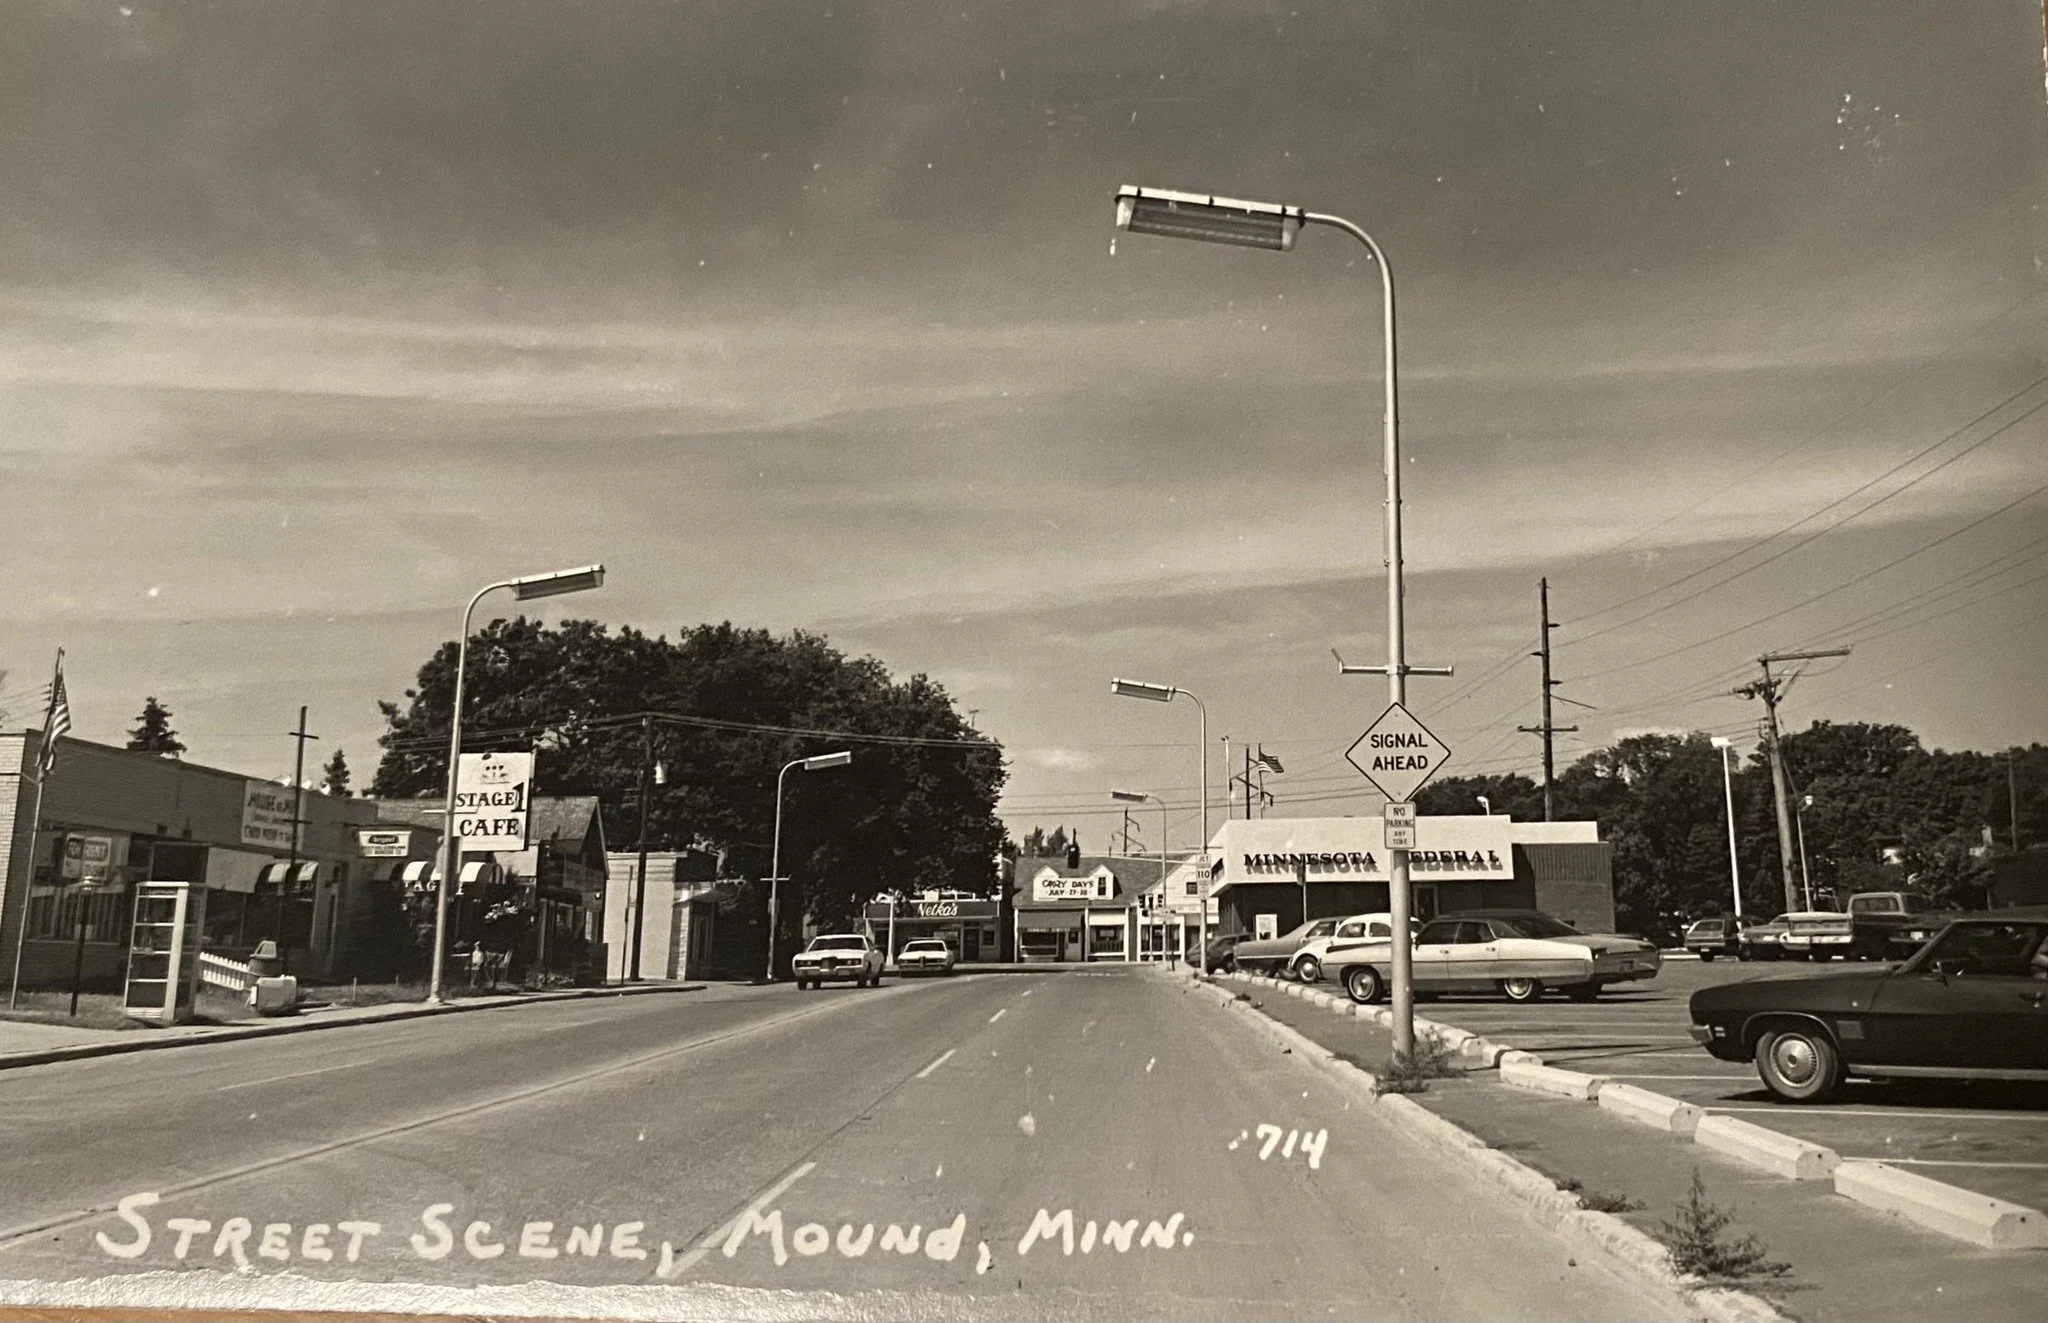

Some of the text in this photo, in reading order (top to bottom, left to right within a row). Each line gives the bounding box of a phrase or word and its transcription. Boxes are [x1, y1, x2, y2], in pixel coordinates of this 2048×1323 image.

[1371, 733, 1428, 748] SIGNAL
[1373, 755, 1428, 770] AHEAD
[457, 782, 526, 812] STAGE 1
[1393, 807, 1405, 816] NO
[460, 818, 519, 836] CAFE
[1386, 819, 1414, 828] PARKING
[1243, 850, 1500, 866] MINNESOTA EDERAL
[1198, 870, 1210, 878] 110
[1042, 879, 1067, 888] CRAZY
